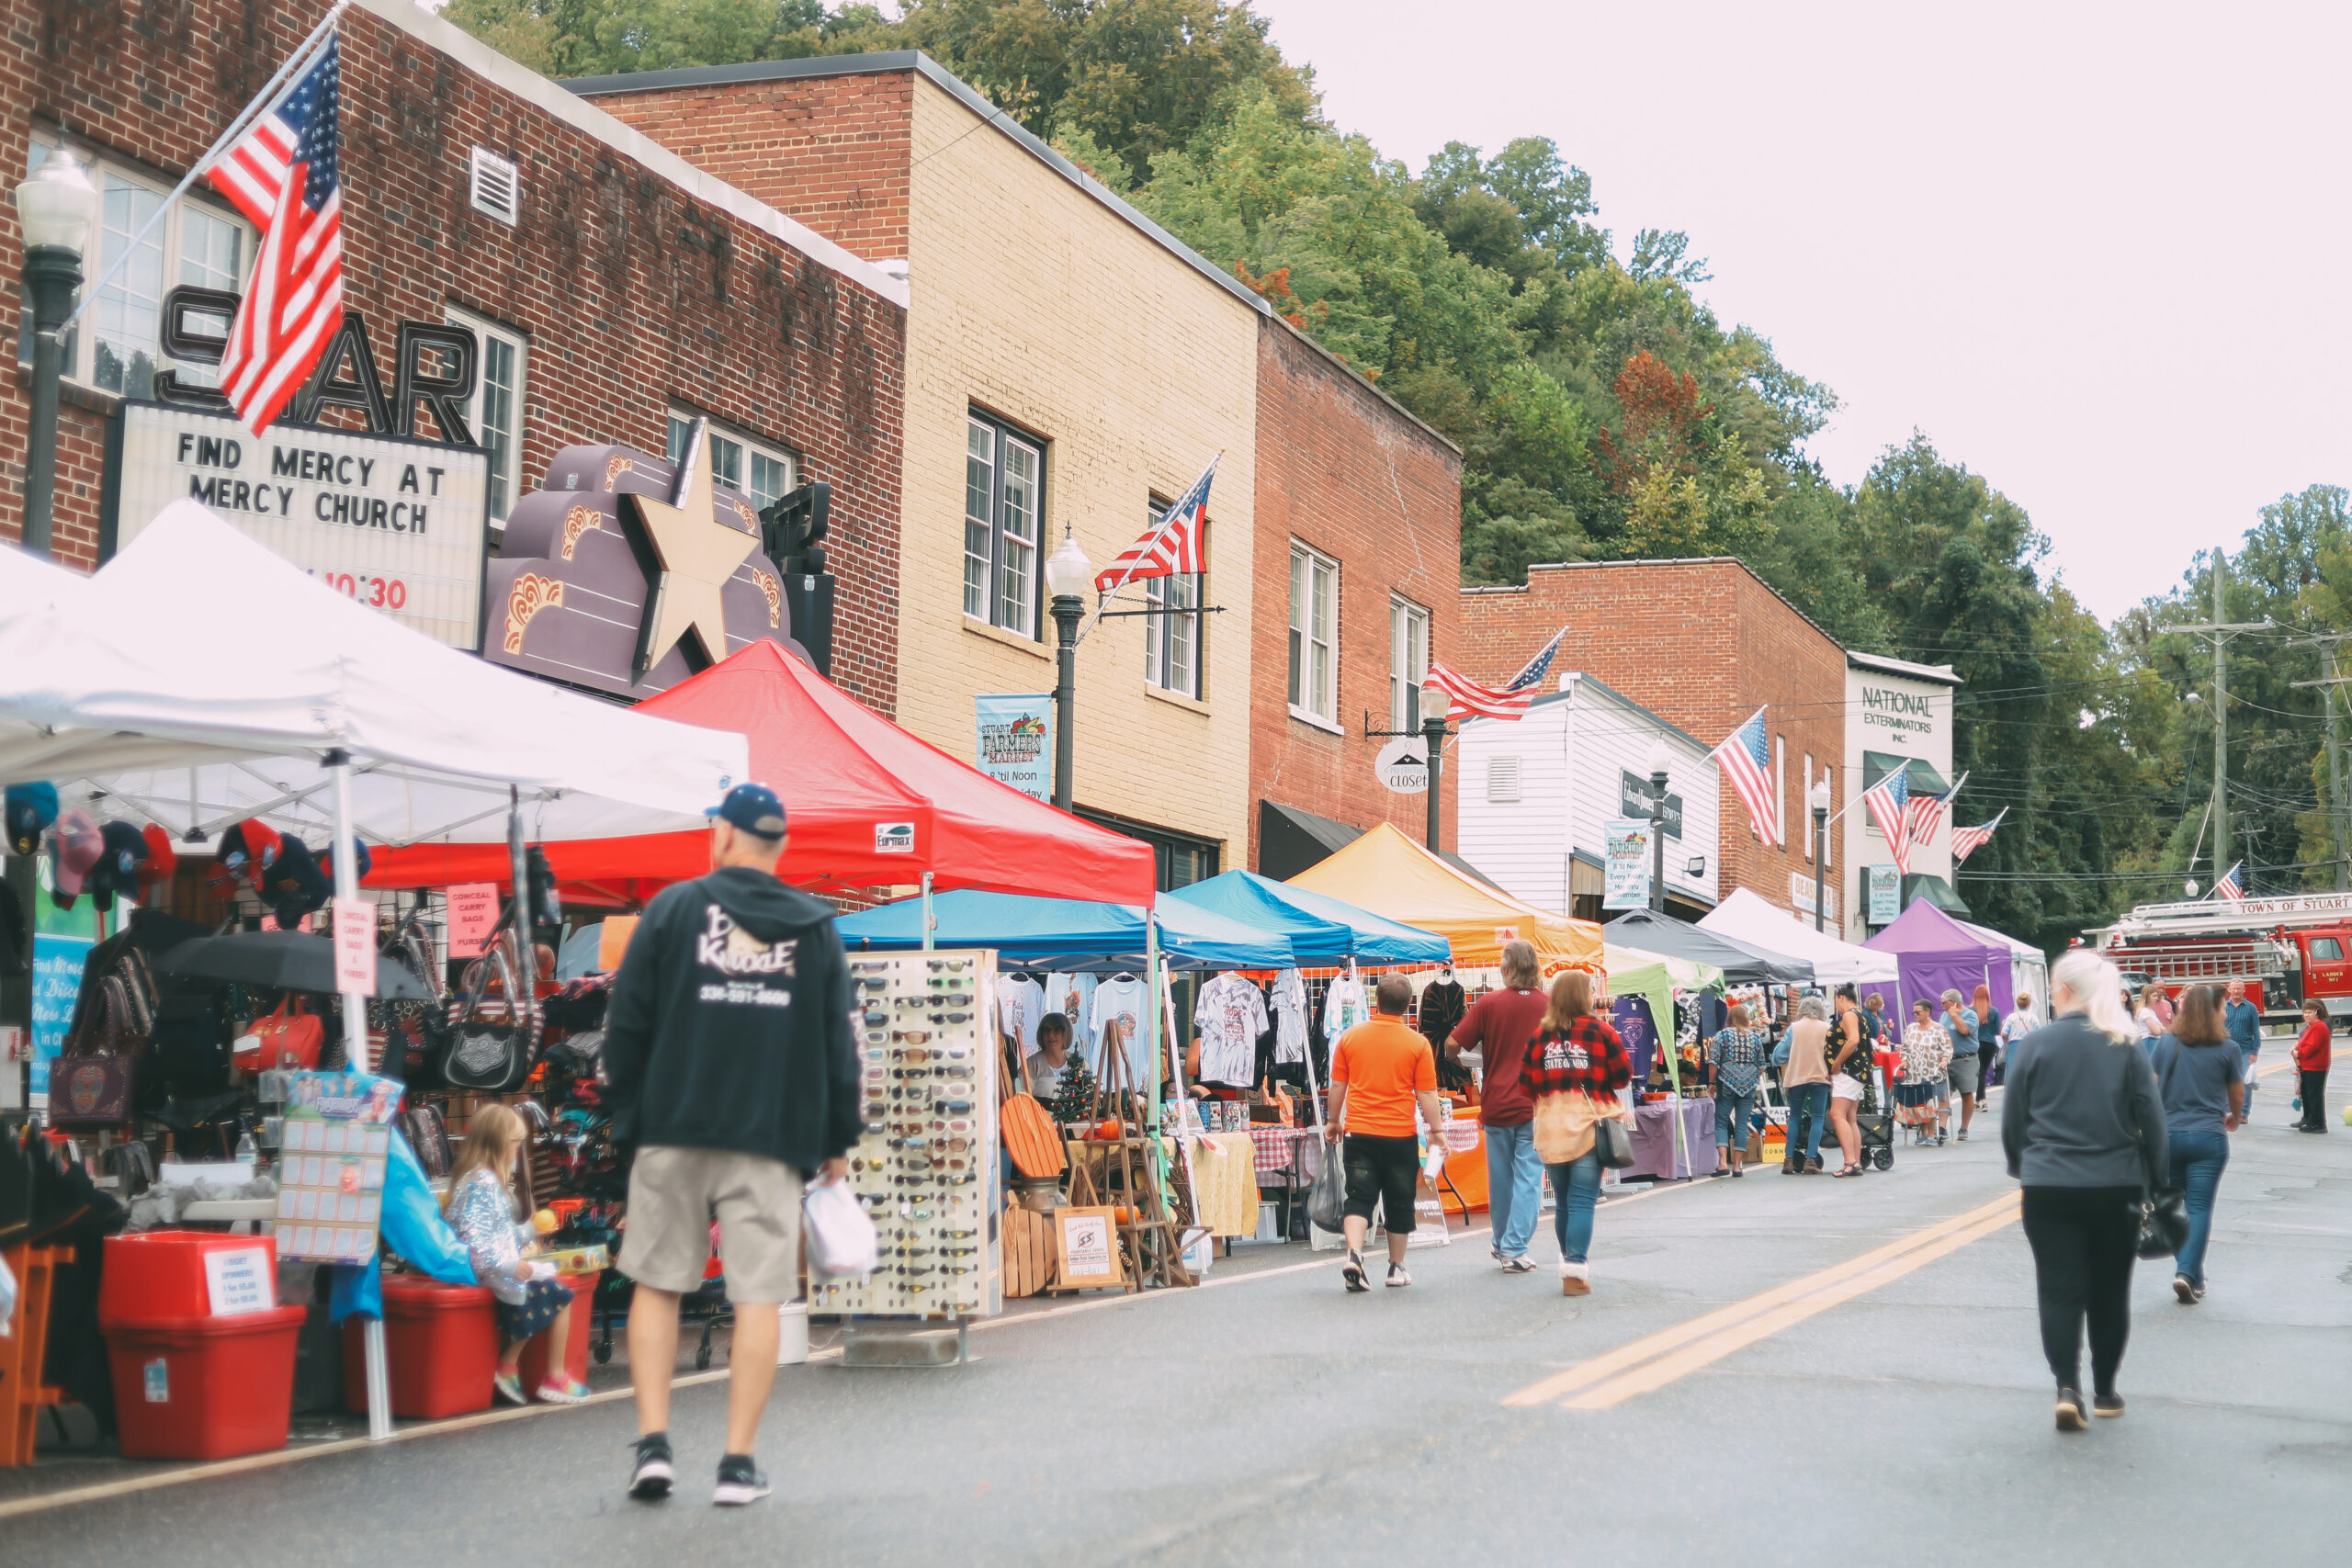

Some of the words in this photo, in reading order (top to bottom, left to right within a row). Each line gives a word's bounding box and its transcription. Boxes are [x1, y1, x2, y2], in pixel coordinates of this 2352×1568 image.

[153, 284, 480, 447] SAR
[176, 432, 243, 470] FIND
[271, 445, 375, 487] MERCY
[398, 463, 445, 497] AT
[188, 474, 294, 516] MERCY
[314, 491, 427, 535] CHURCH
[324, 572, 407, 610] 10:30
[1862, 686, 1934, 718] NATIONAL
[981, 724, 1011, 734] STUART
[1864, 712, 1932, 734] EXTERMINATORS
[988, 750, 1036, 763] MARKET
[1012, 772, 1037, 781] Noon
[1623, 780, 1641, 807] Edward
[1610, 874, 1626, 882] Every
[452, 892, 492, 901] CONCEAL
[458, 904, 486, 912] CARRY
[2240, 903, 2275, 914] TOWN
[2281, 901, 2297, 911] OF
[2303, 898, 2350, 910] STUART
[461, 915, 485, 923] BAGS
[458, 937, 486, 946] PURSE
[1544, 1057, 1563, 1071] STATE
